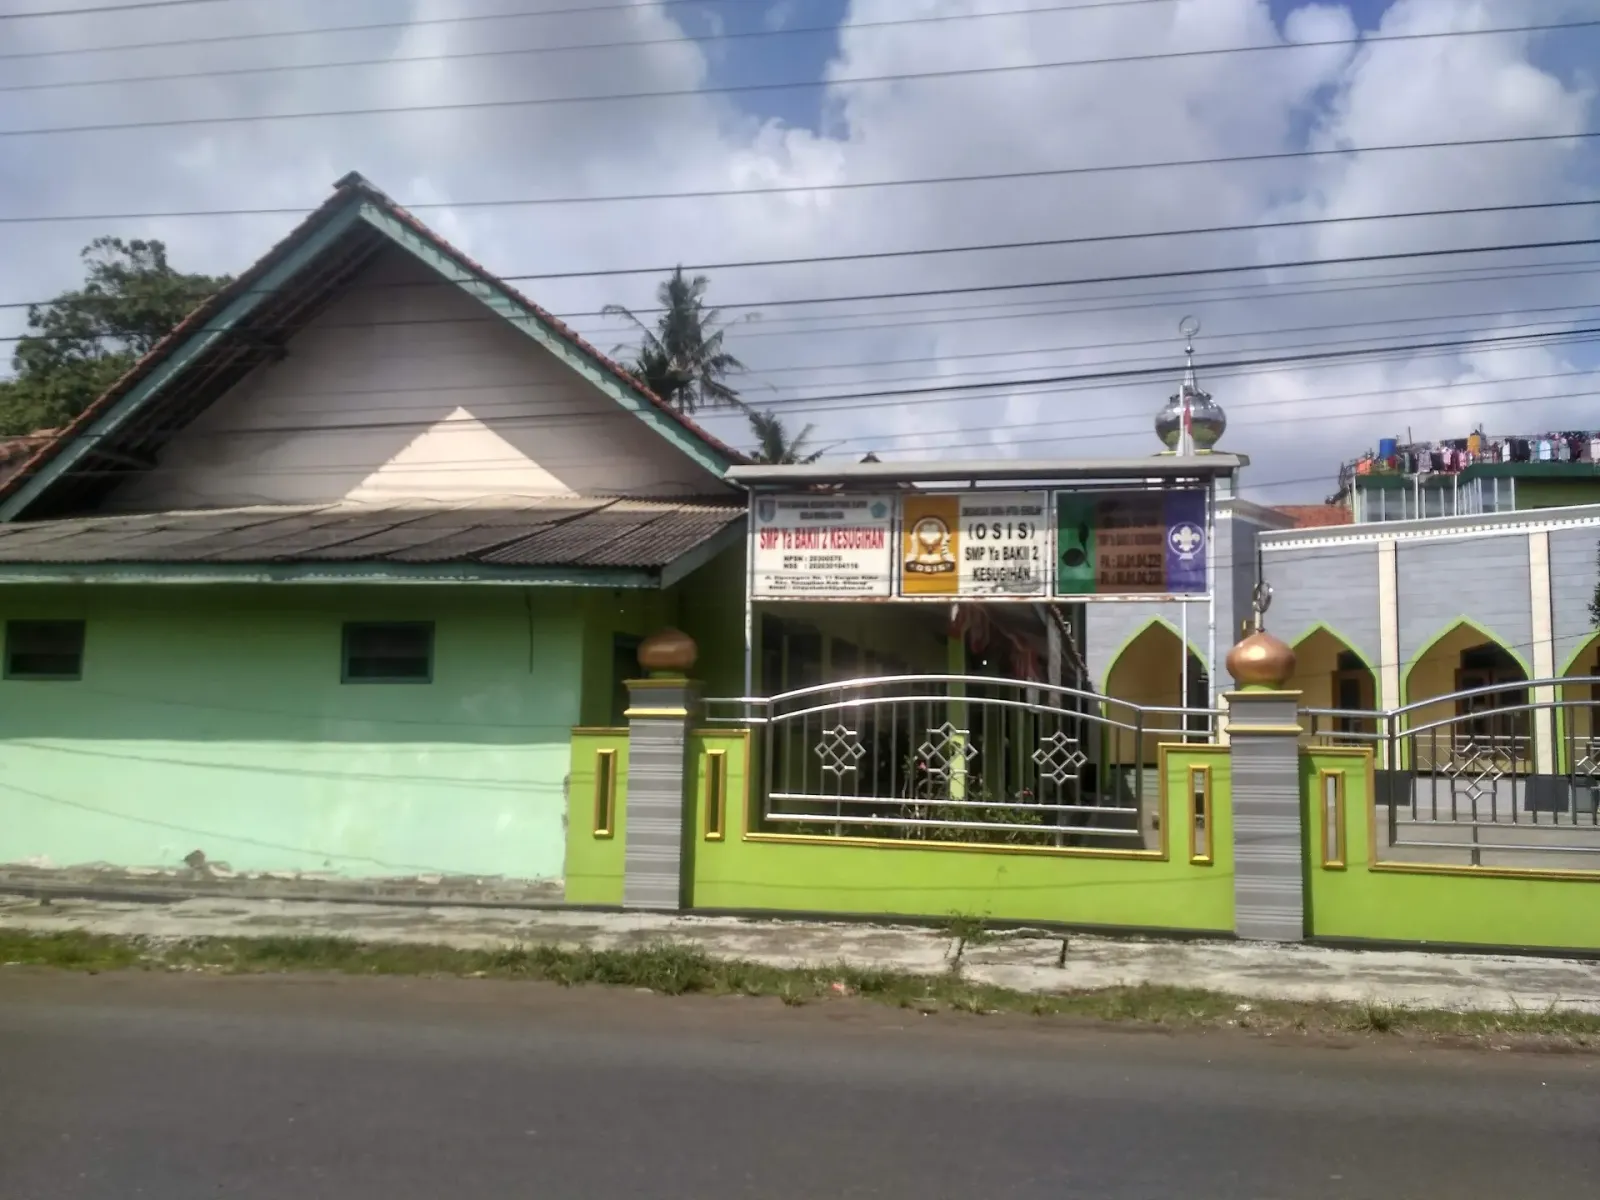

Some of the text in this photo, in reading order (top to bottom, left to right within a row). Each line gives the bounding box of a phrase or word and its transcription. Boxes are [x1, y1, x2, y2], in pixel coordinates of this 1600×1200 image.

[760, 527, 779, 549] SMP
[782, 528, 792, 549] Ya
[822, 527, 828, 549] 2
[830, 527, 885, 549] KESUGIHAN
[965, 546, 986, 561] SMP
[989, 546, 1000, 561] Ya
[1032, 545, 1039, 561] 2
[973, 566, 1031, 582] KESUGIHAN
